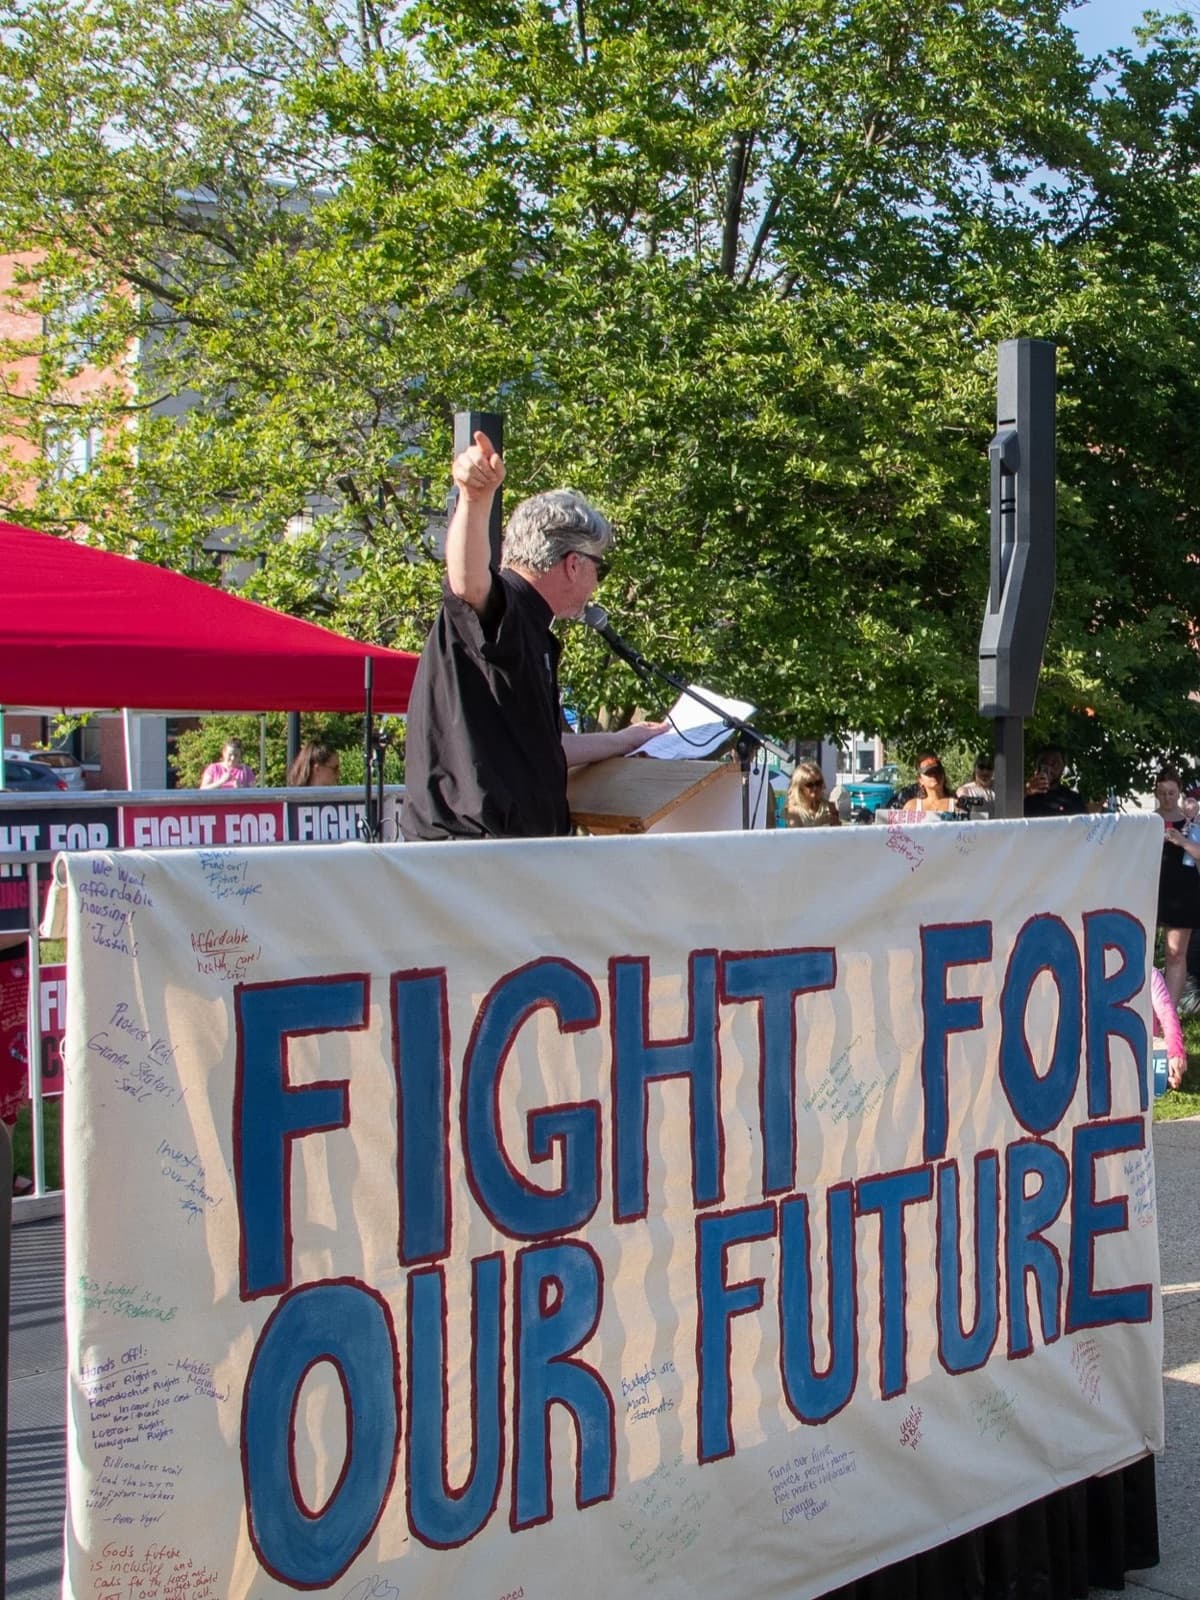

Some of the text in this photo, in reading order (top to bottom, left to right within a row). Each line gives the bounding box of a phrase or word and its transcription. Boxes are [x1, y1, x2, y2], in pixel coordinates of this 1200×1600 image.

[79, 879, 155, 908] affordable
[234, 908, 1150, 1302] FIGHT FOR
[240, 1115, 1153, 1592] OUR FUTURE
[123, 1369, 159, 1388] Rights
[102, 1541, 135, 1559] God's
[89, 1561, 103, 1572] is
